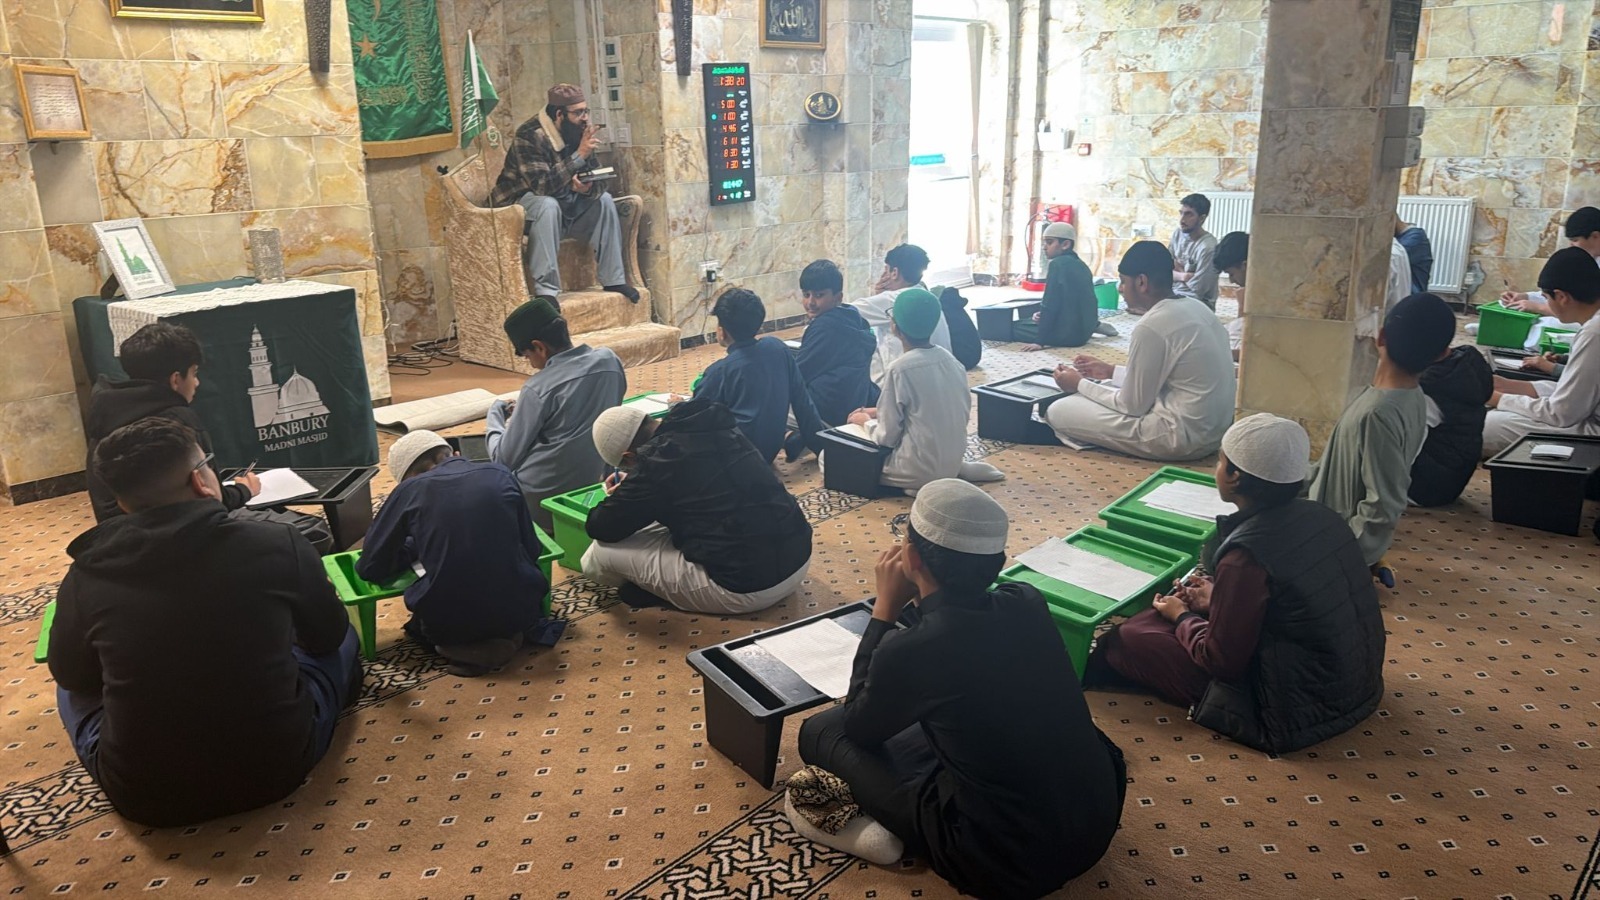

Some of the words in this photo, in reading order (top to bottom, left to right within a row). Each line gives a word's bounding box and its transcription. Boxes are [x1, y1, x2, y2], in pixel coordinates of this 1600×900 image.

[258, 415, 329, 441] BANBURY
[264, 439, 297, 453] MADNI
[297, 432, 328, 446] MASJID
